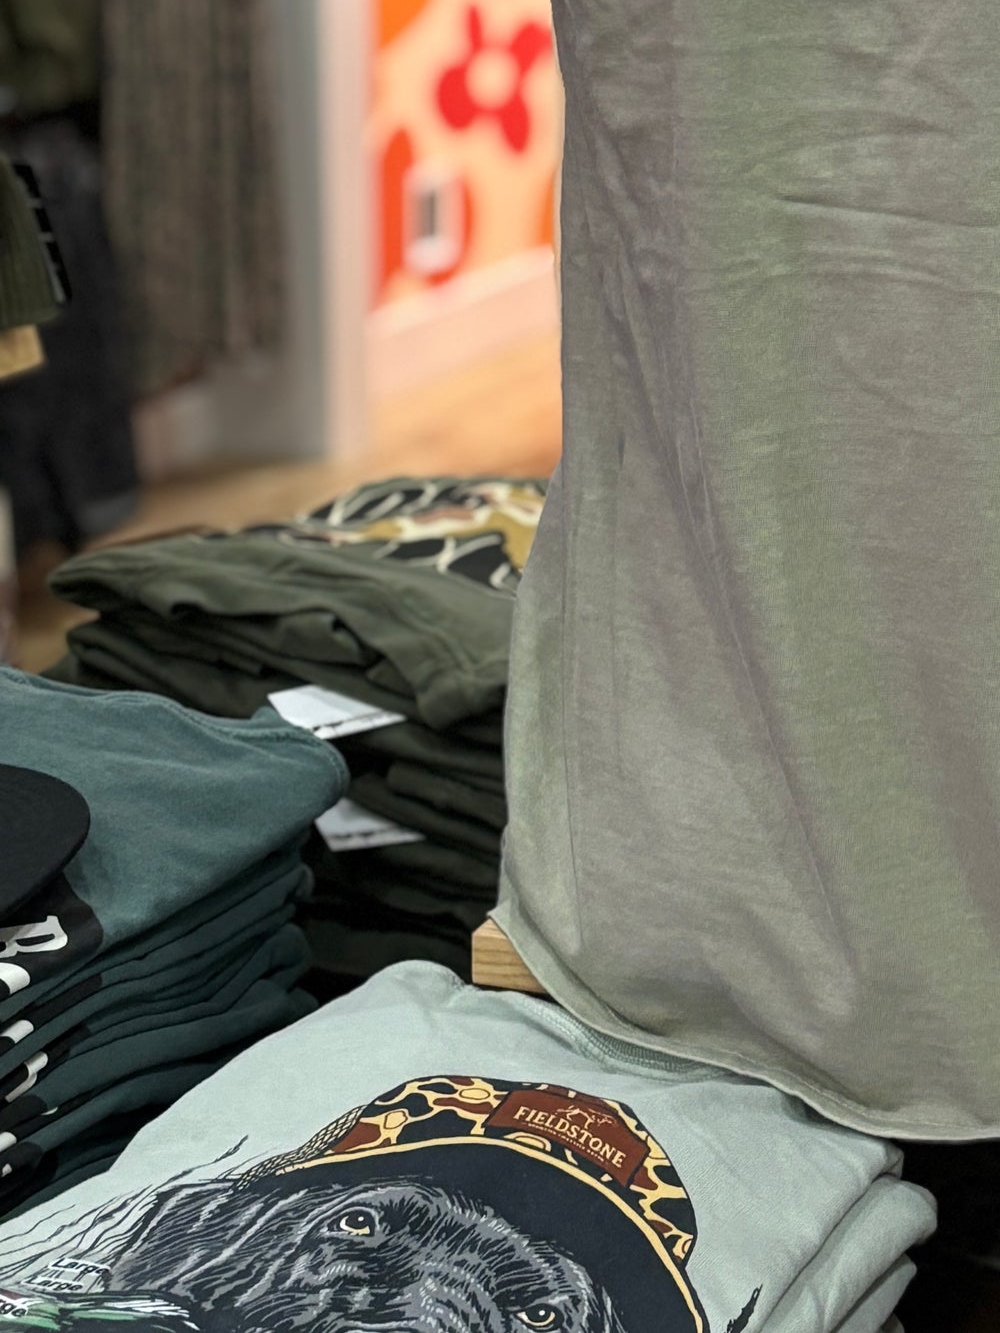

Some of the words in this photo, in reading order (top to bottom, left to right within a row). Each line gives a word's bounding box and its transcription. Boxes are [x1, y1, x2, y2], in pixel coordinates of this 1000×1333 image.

[513, 1105, 627, 1168] FIELDSTONE
[52, 1258, 109, 1275] Large
[24, 1276, 82, 1291] Large
